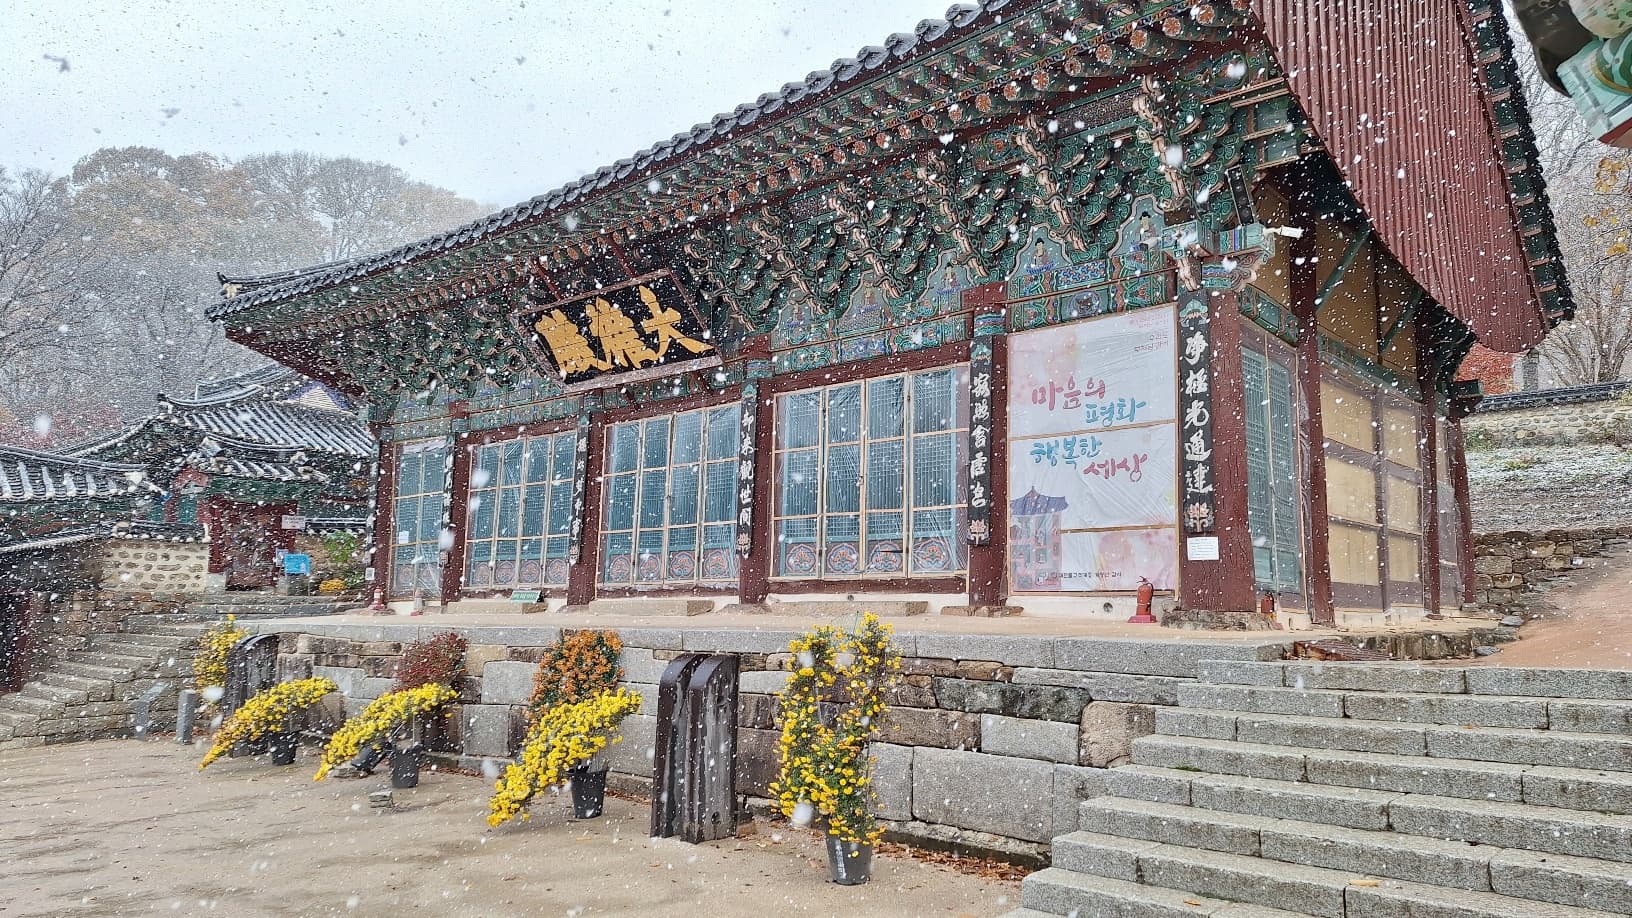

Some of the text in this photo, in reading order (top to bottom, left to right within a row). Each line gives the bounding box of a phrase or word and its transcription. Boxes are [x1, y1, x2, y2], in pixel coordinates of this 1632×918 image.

[1032, 376, 1105, 411] 마음의
[1085, 398, 1147, 427] 평화
[1030, 436, 1103, 470] 행복한
[1083, 454, 1148, 482] 세상
